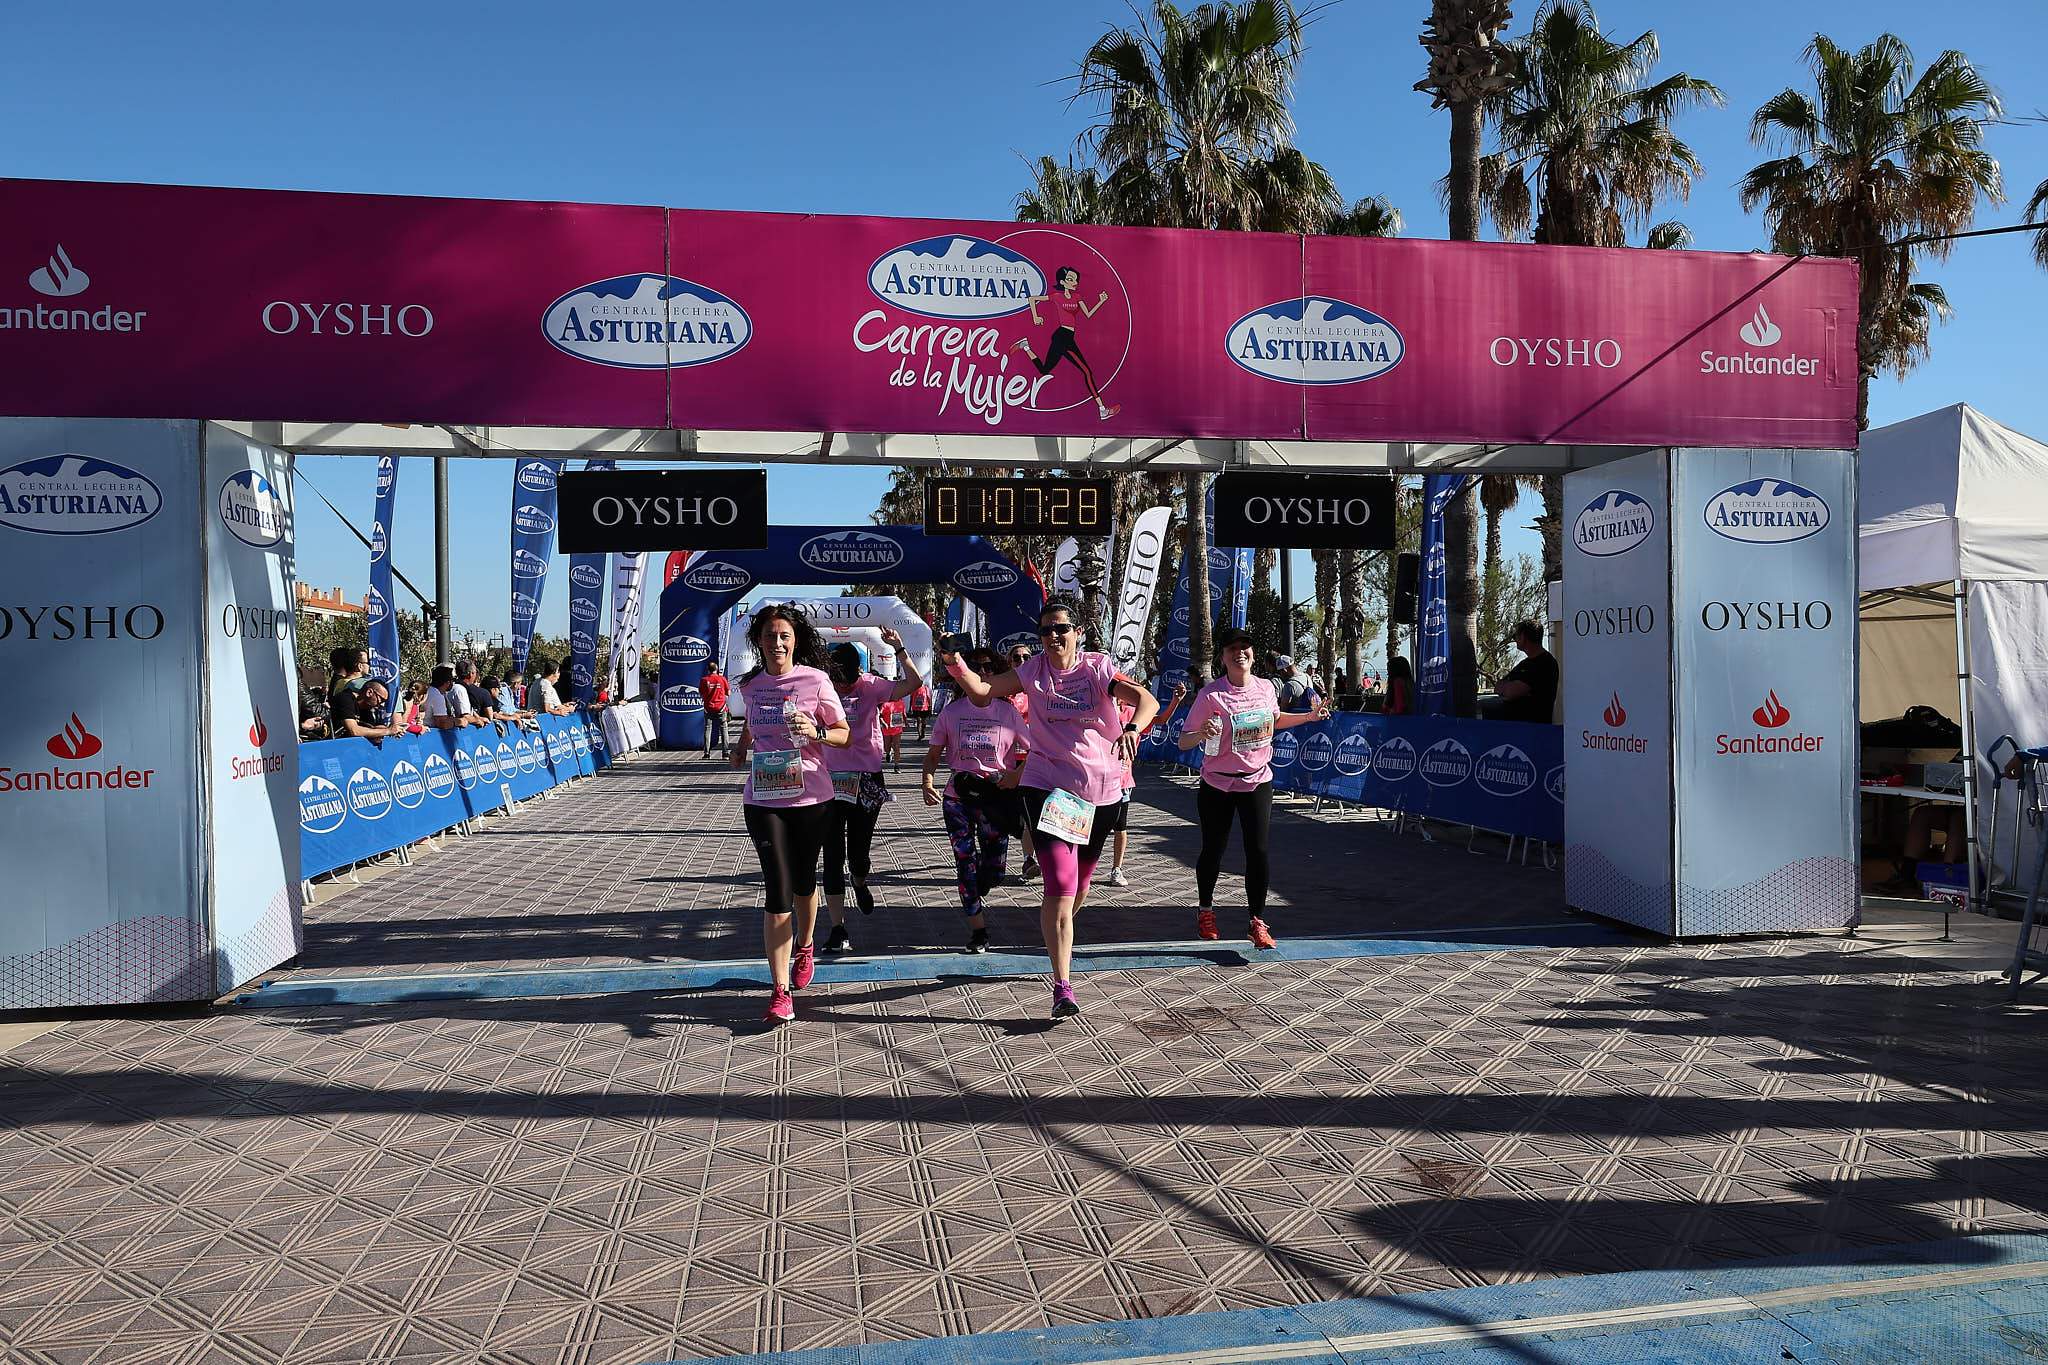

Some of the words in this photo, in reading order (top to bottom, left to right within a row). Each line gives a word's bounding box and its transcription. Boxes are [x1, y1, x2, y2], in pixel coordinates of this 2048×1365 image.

[883, 263, 1033, 300] ASTURIANA
[910, 262, 965, 274] CENTRAL
[970, 264, 1027, 275] LECHERA
[0, 303, 147, 332] antander
[262, 301, 434, 337] OYSHO
[592, 306, 656, 316] CENTRAL
[558, 306, 736, 345] ASTURIANA
[853, 310, 999, 357] Carrera
[1267, 325, 1322, 336] CENTRAL
[1328, 326, 1385, 337] LECHERA
[1240, 327, 1391, 363] ASTURIANA
[1490, 337, 1623, 369] OYSHO
[1700, 350, 1820, 377] Santander
[890, 364, 917, 388] de
[923, 367, 942, 389] la
[939, 352, 1054, 425] Mujer
[225, 491, 283, 534] ASTURIANA
[592, 496, 739, 526] OYSHO
[939, 488, 1098, 525] 01:07:28
[1245, 496, 1371, 526] OYSHO
[1713, 502, 1820, 527] ASTURIANA
[1578, 515, 1648, 545] ASTURIANA
[809, 544, 895, 564] ASTURIANA
[688, 573, 746, 585] ASTURIANA
[960, 573, 1013, 585] ASTURIANA
[1115, 530, 1160, 663] OYSHO
[223, 604, 288, 641] OYSHO
[1575, 604, 1654, 637] OYSHO
[1701, 601, 1832, 631] OYSHO
[663, 645, 708, 657] ASTURIANA
[1582, 730, 1648, 754] Santander
[1716, 733, 1823, 755] Santander
[232, 751, 285, 779] Santander
[1375, 752, 1412, 771] ASTURIANA
[1422, 755, 1467, 777] ASTURIANA
[1477, 760, 1529, 786] ASTURIANA
[0, 767, 155, 791] Santander
[394, 780, 424, 799] ASTURIANA
[426, 772, 454, 790] ASTURIANA
[300, 800, 344, 823] ASTURIANA
[351, 788, 390, 810] ASTURIANA
